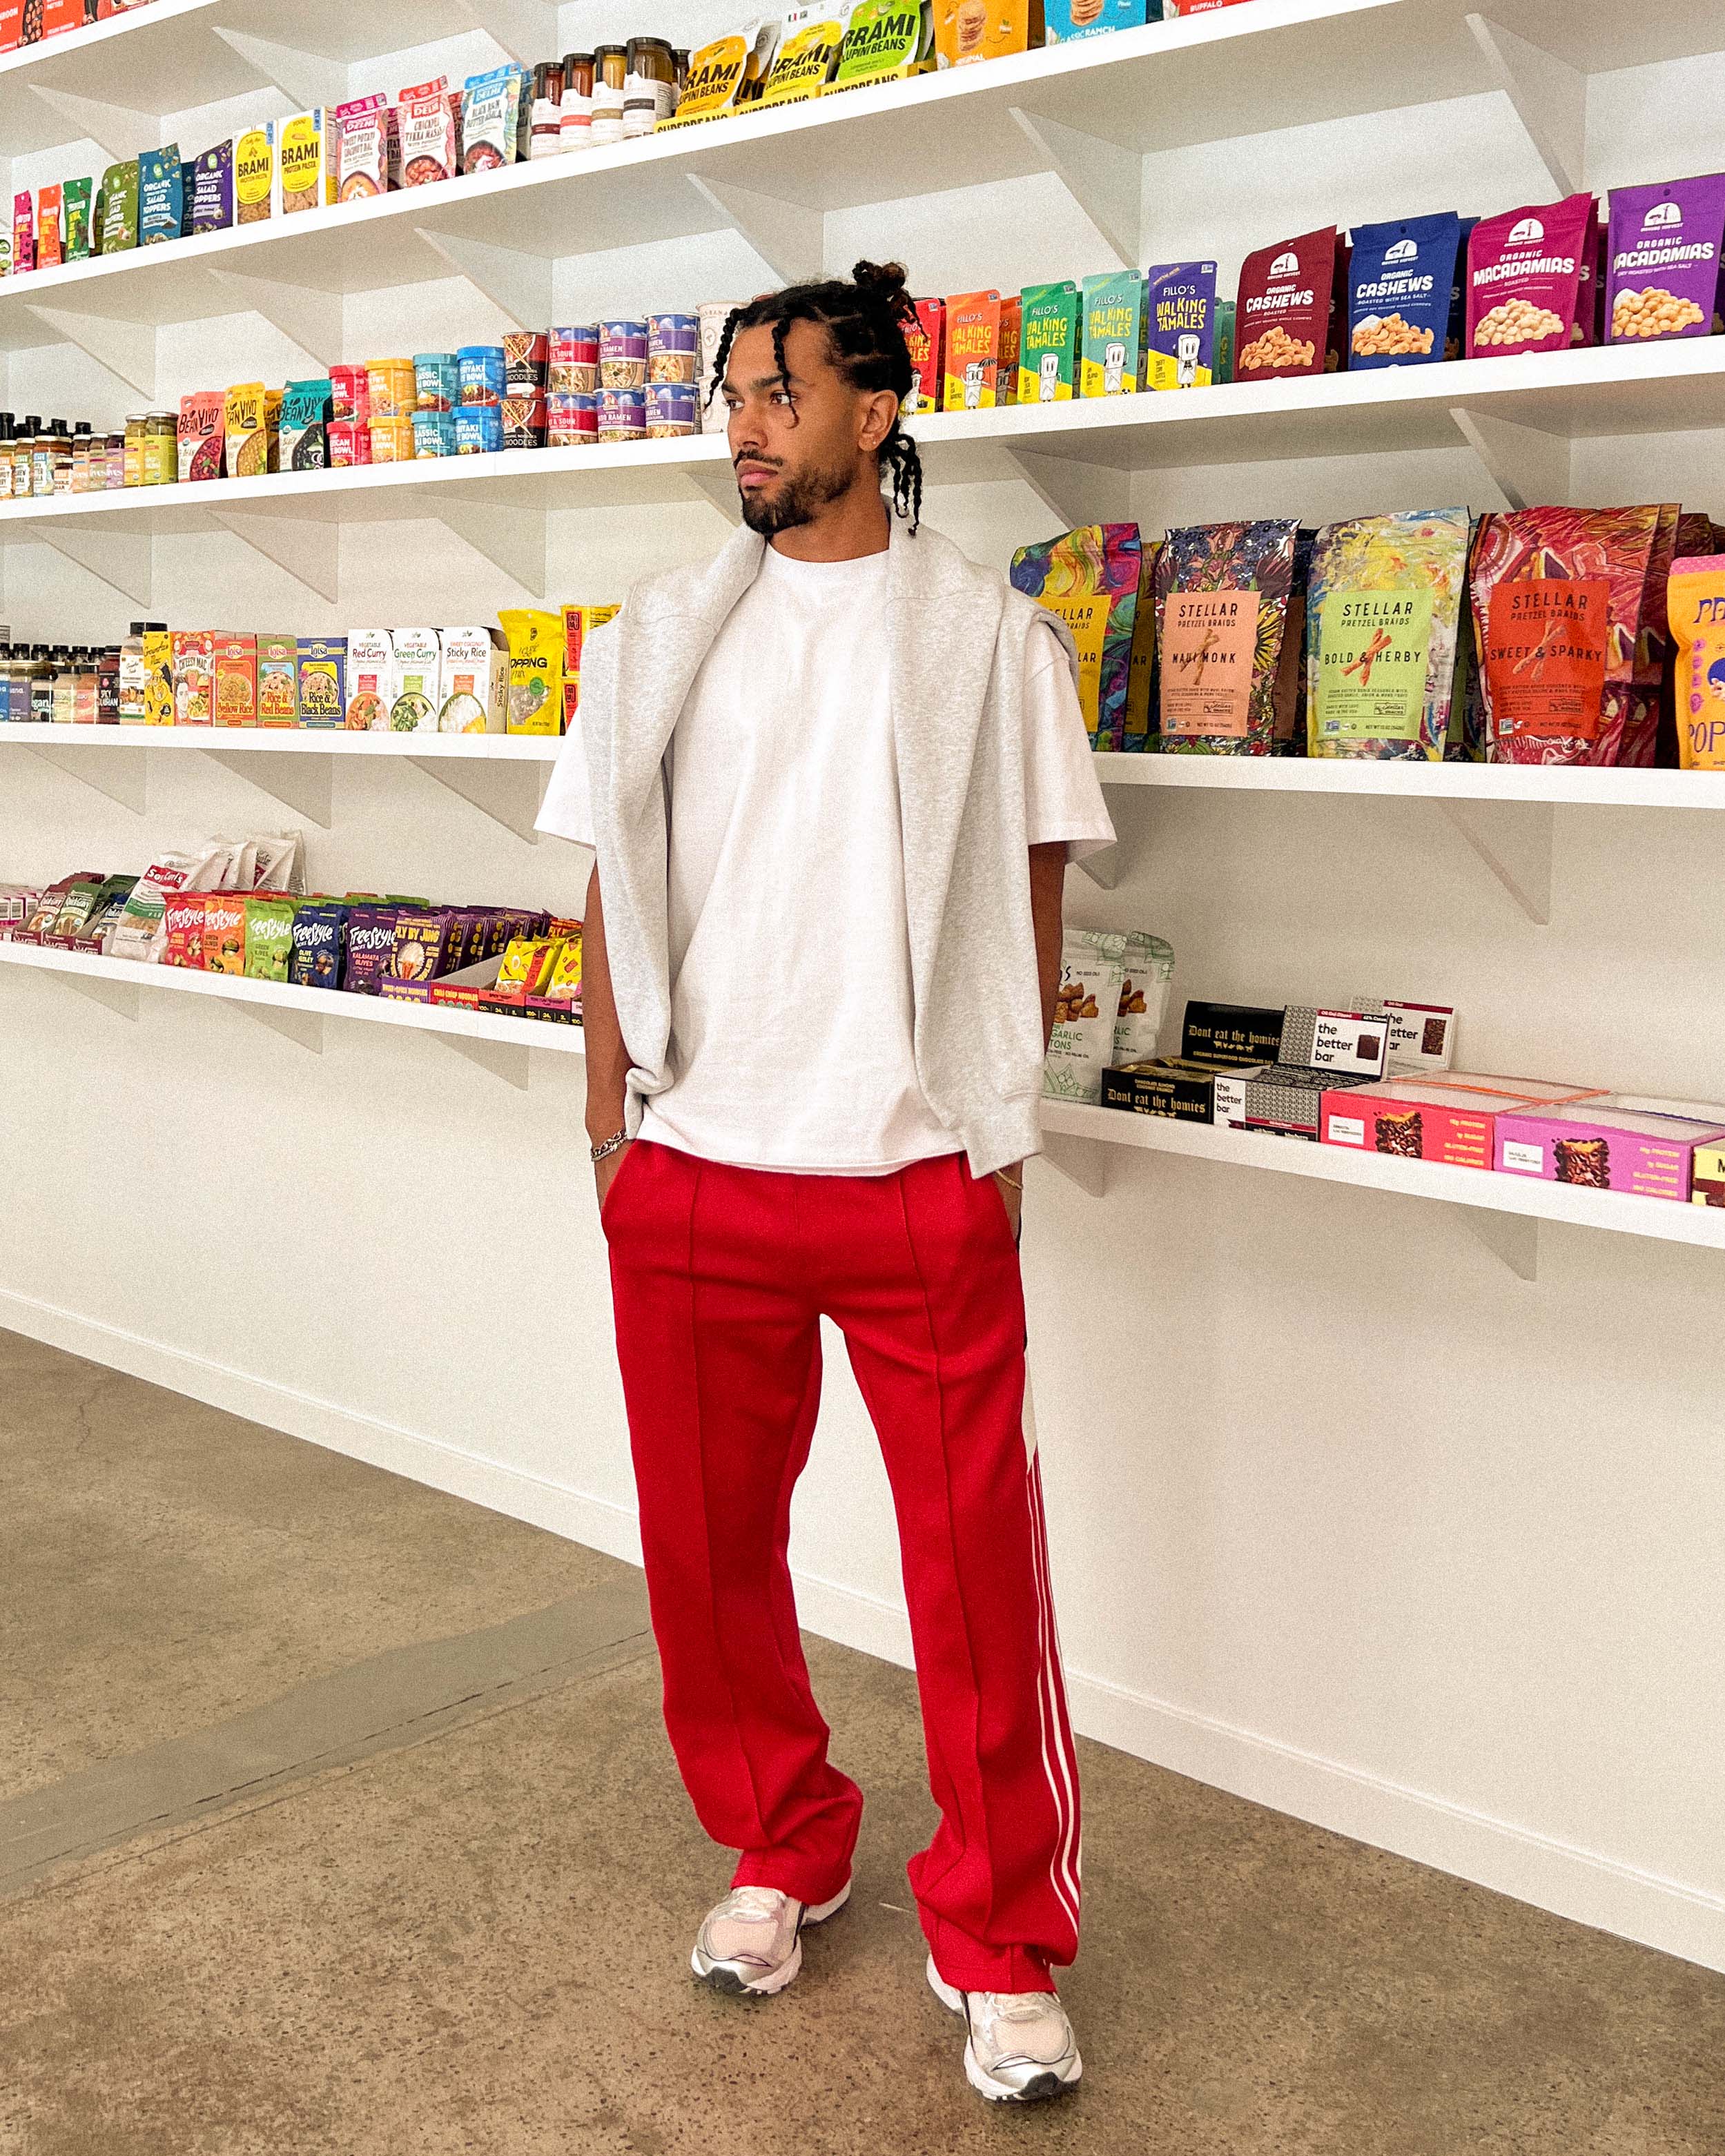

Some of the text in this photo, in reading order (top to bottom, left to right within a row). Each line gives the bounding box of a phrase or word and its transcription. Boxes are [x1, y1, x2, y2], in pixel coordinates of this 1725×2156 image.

[1190, 1, 1222, 12] BUFFALO
[846, 13, 916, 48] BRAMI
[1085, 26, 1115, 37] RANCH
[871, 38, 906, 54] BEANS
[789, 63, 821, 79] BEANS
[699, 82, 730, 99] BEANS
[282, 142, 319, 166] BRAMI
[238, 157, 269, 177] BRAMI
[302, 161, 317, 170] PASTA
[196, 170, 224, 182] ORGANIC
[144, 179, 171, 192] ORGANIC
[196, 185, 217, 195] SALAD
[146, 194, 166, 205] SALAD
[143, 203, 171, 215] TOPPERS
[1637, 237, 1682, 249] ORGANIC
[1499, 250, 1543, 262] ORGANIC
[1381, 268, 1414, 281] ORGANIC
[1473, 257, 1576, 287] MACADAMIAS
[1356, 275, 1434, 298] CASHEWS
[1504, 277, 1530, 287] ROASTED
[1163, 285, 1196, 297] FILLO'S
[1266, 284, 1296, 295] ORGANIC
[1094, 294, 1122, 305] FILLO'S
[1246, 290, 1314, 313] CASHEWS
[1032, 304, 1059, 316] FILLO'S
[1156, 297, 1207, 317] WALKING
[957, 313, 983, 324] FILLO'S
[1089, 308, 1133, 326] WALKING
[1157, 313, 1205, 332] TAMALES
[1027, 317, 1068, 336] WALKING
[1089, 322, 1131, 339] TAMALES
[1027, 332, 1066, 350] TAMALES
[240, 399, 257, 420] VIVO
[281, 400, 302, 424] BEAN
[179, 408, 219, 433] BEAN VIVO
[559, 418, 576, 426] SOUR
[422, 437, 445, 445] BOWL
[1512, 595, 1588, 610] STELLAR
[1179, 603, 1238, 618] STELLAR
[1343, 602, 1414, 616] STELLAR
[1510, 611, 1585, 620] PRETZEL BRAIDS
[1178, 619, 1236, 628] PRETZEL BRAIDS
[1341, 618, 1410, 627] PRETZEL BRAIDS
[353, 648, 387, 660] Red Curry
[394, 648, 437, 660] Green Curry
[447, 647, 487, 659] Sticky Rice
[1172, 652, 1236, 664] MAUI MONK
[1325, 652, 1354, 665] BOLD
[1375, 651, 1421, 663] HERBY
[1490, 645, 1602, 660] SWEET & SPARKY
[179, 656, 207, 671] CHEESY MAC
[267, 691, 281, 703] Rice
[309, 691, 323, 703] Rice
[240, 702, 253, 714] Rice
[261, 703, 294, 715] Red Beans
[301, 703, 341, 716] Black Beans
[147, 868, 183, 885] Soy Curls
[408, 927, 440, 943] BY JING
[353, 952, 379, 961] KALAMATA
[355, 959, 373, 968] OLIVES
[433, 988, 445, 997] CHILI
[1051, 1029, 1083, 1041] GARLIC
[1318, 1023, 1338, 1035] the
[1189, 1025, 1280, 1046] Dont eat the homies
[1316, 1036, 1353, 1050] better
[1314, 1050, 1334, 1062] bar
[1216, 1082, 1231, 1092] the
[1107, 1088, 1206, 1113] Dont eat the homies
[1216, 1093, 1242, 1104] better
[1216, 1104, 1231, 1113] bar
